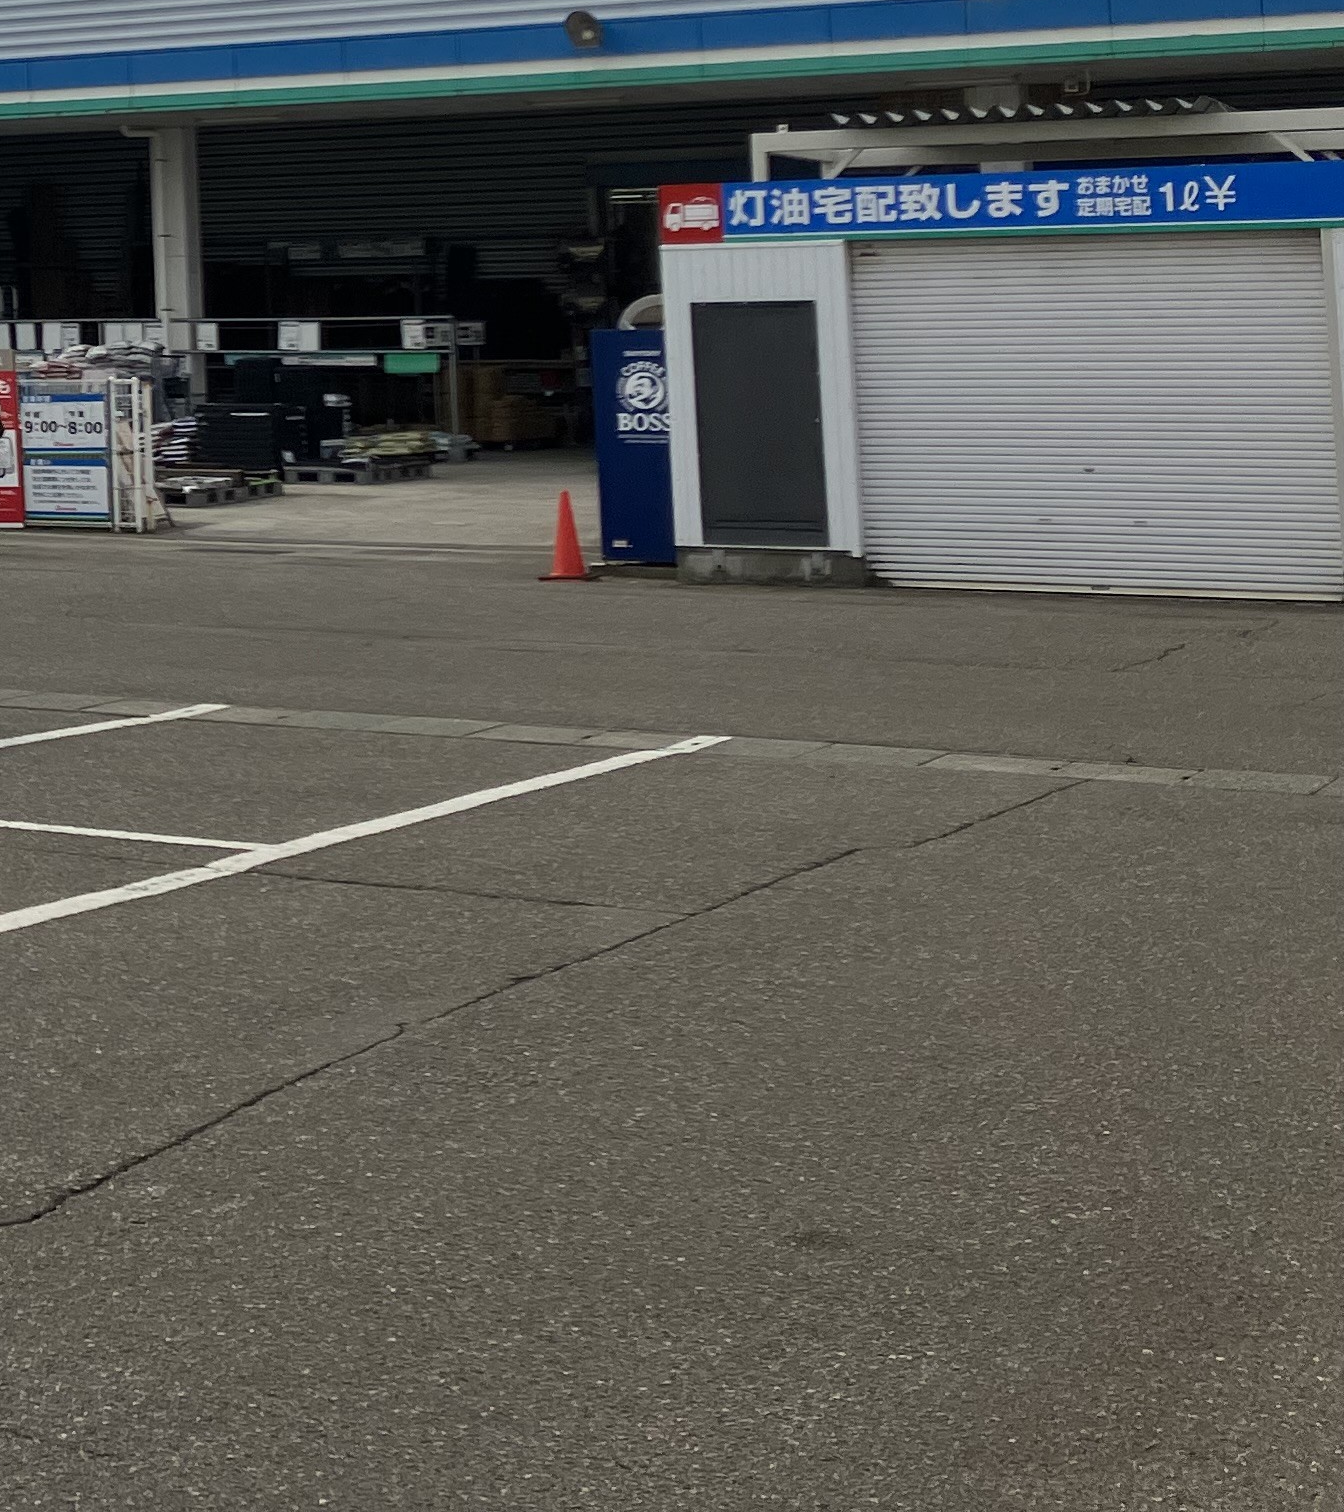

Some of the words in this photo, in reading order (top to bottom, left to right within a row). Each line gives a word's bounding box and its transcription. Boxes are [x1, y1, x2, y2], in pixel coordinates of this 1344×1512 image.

[1076, 174, 1149, 195] おまかせ
[728, 179, 1070, 227] 灯油宅配致します
[1076, 195, 1152, 217] 定期宅配
[616, 412, 671, 432] BOSS
